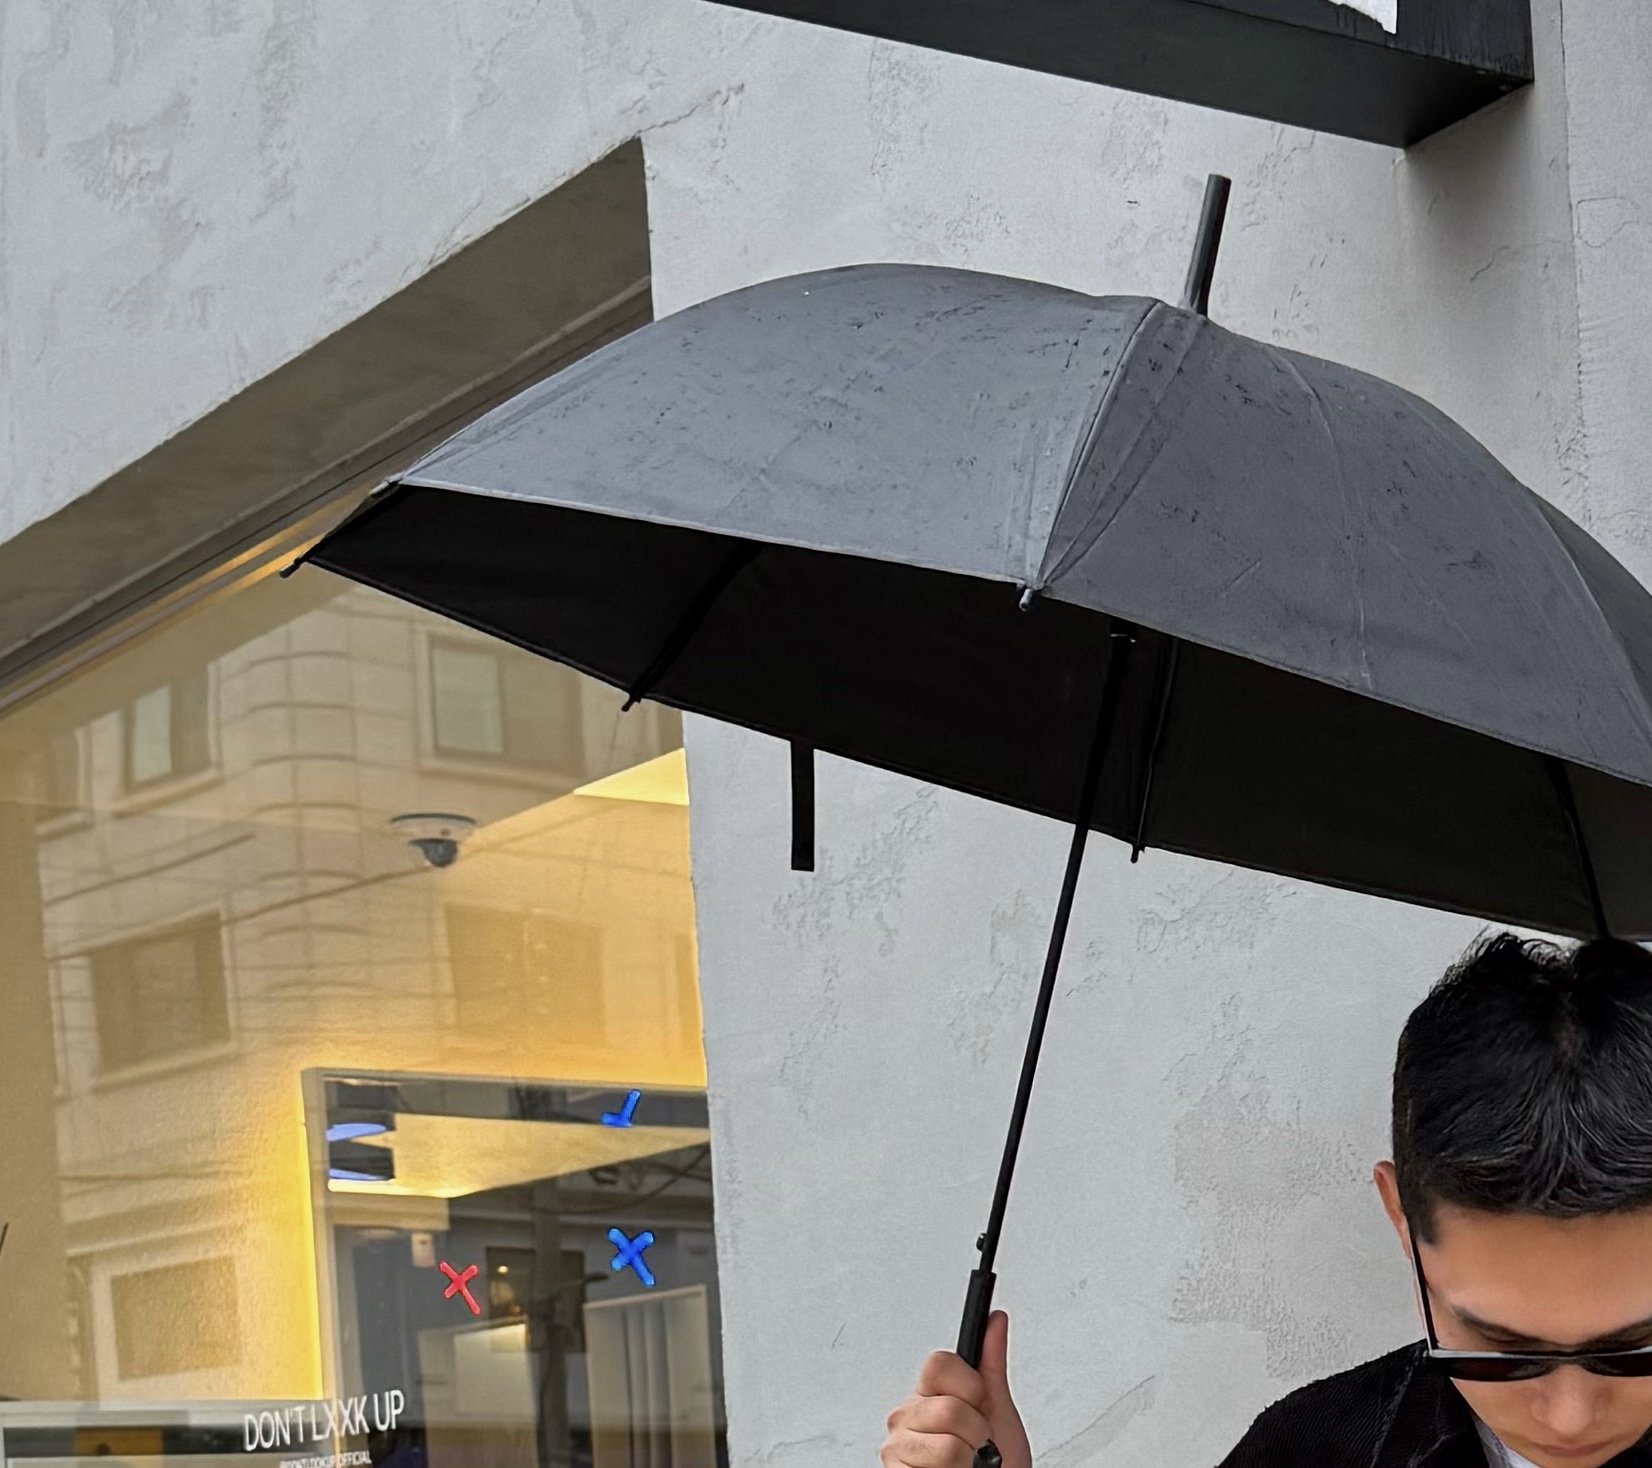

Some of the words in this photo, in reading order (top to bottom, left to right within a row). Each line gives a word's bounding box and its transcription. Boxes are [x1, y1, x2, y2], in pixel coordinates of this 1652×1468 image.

[244, 1405, 306, 1451] DON'T
[311, 1395, 370, 1441] LXXK
[373, 1389, 405, 1432] UP
